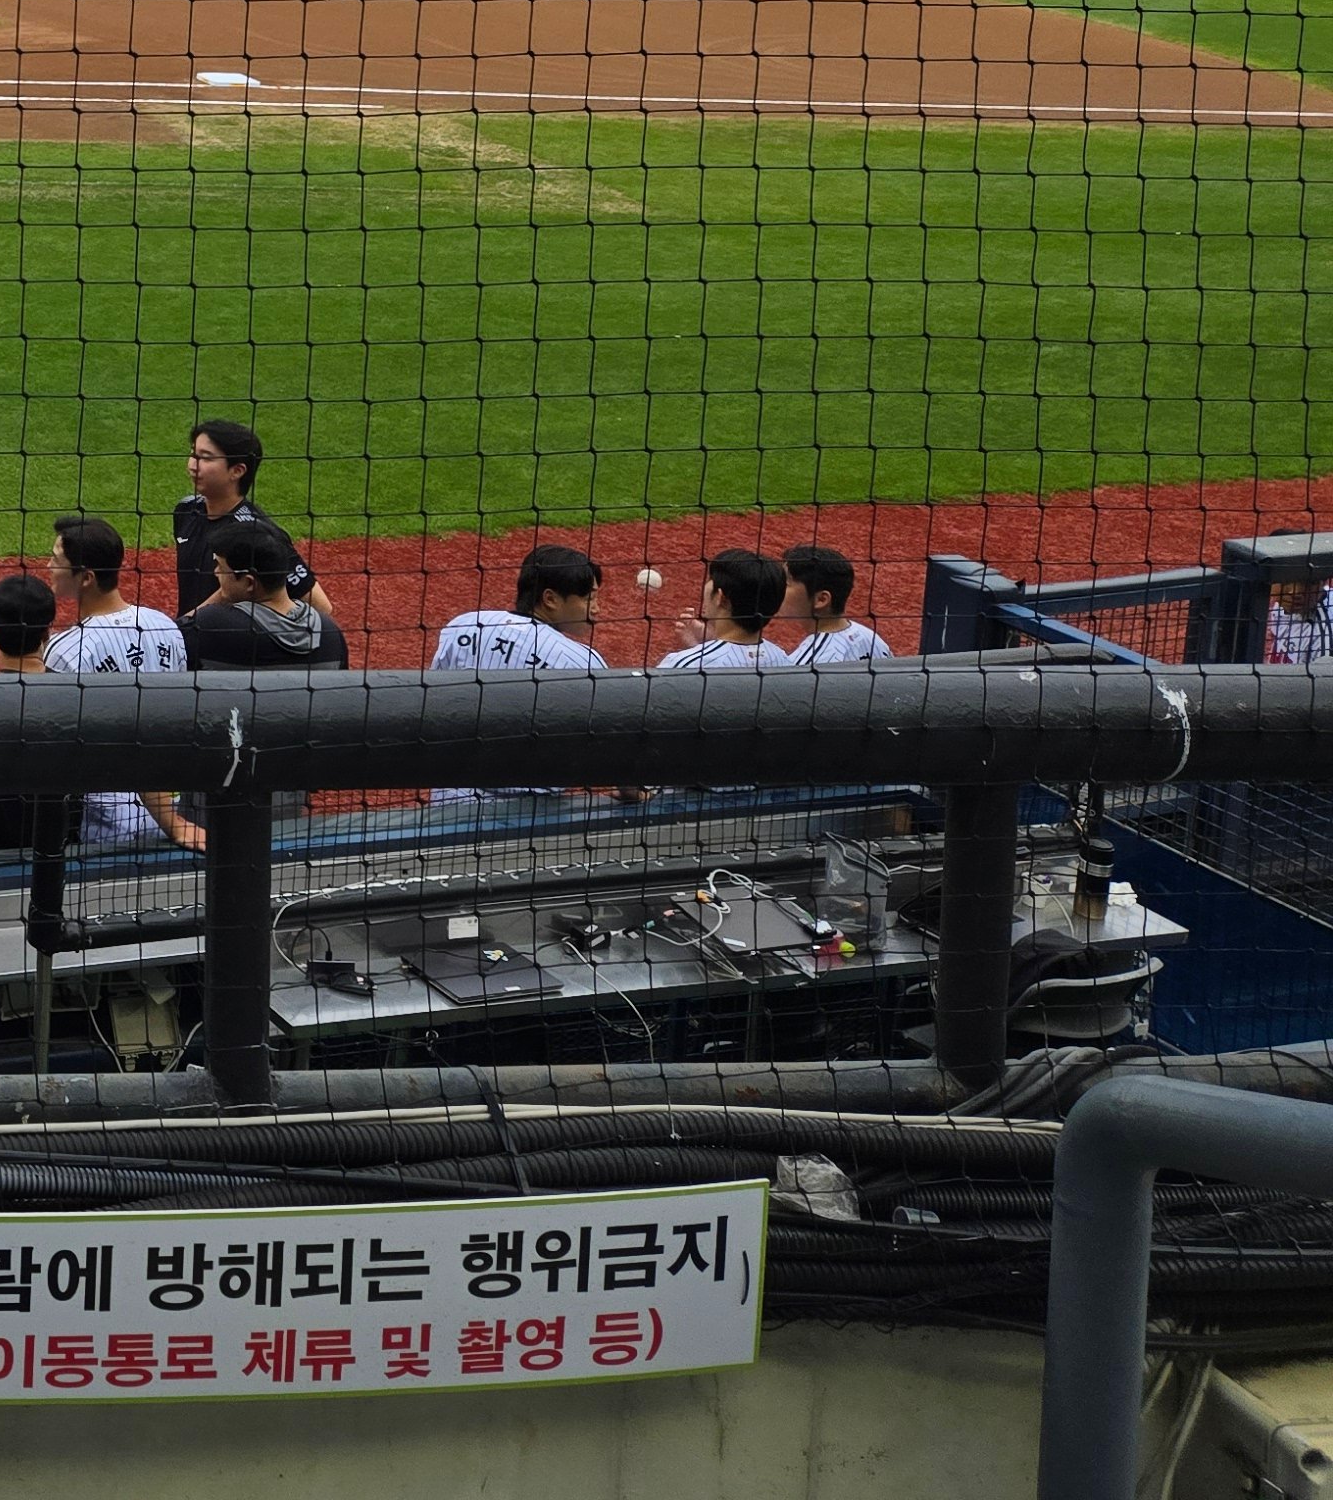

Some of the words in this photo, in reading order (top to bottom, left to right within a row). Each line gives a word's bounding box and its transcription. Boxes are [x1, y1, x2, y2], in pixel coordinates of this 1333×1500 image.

[145, 1235, 426, 1311] 방해되는
[461, 1215, 729, 1295] 행위금지
[243, 1325, 356, 1385] 체류
[380, 1327, 434, 1381] 및
[456, 1314, 565, 1374] 촬영
[589, 1306, 665, 1366] 등)
